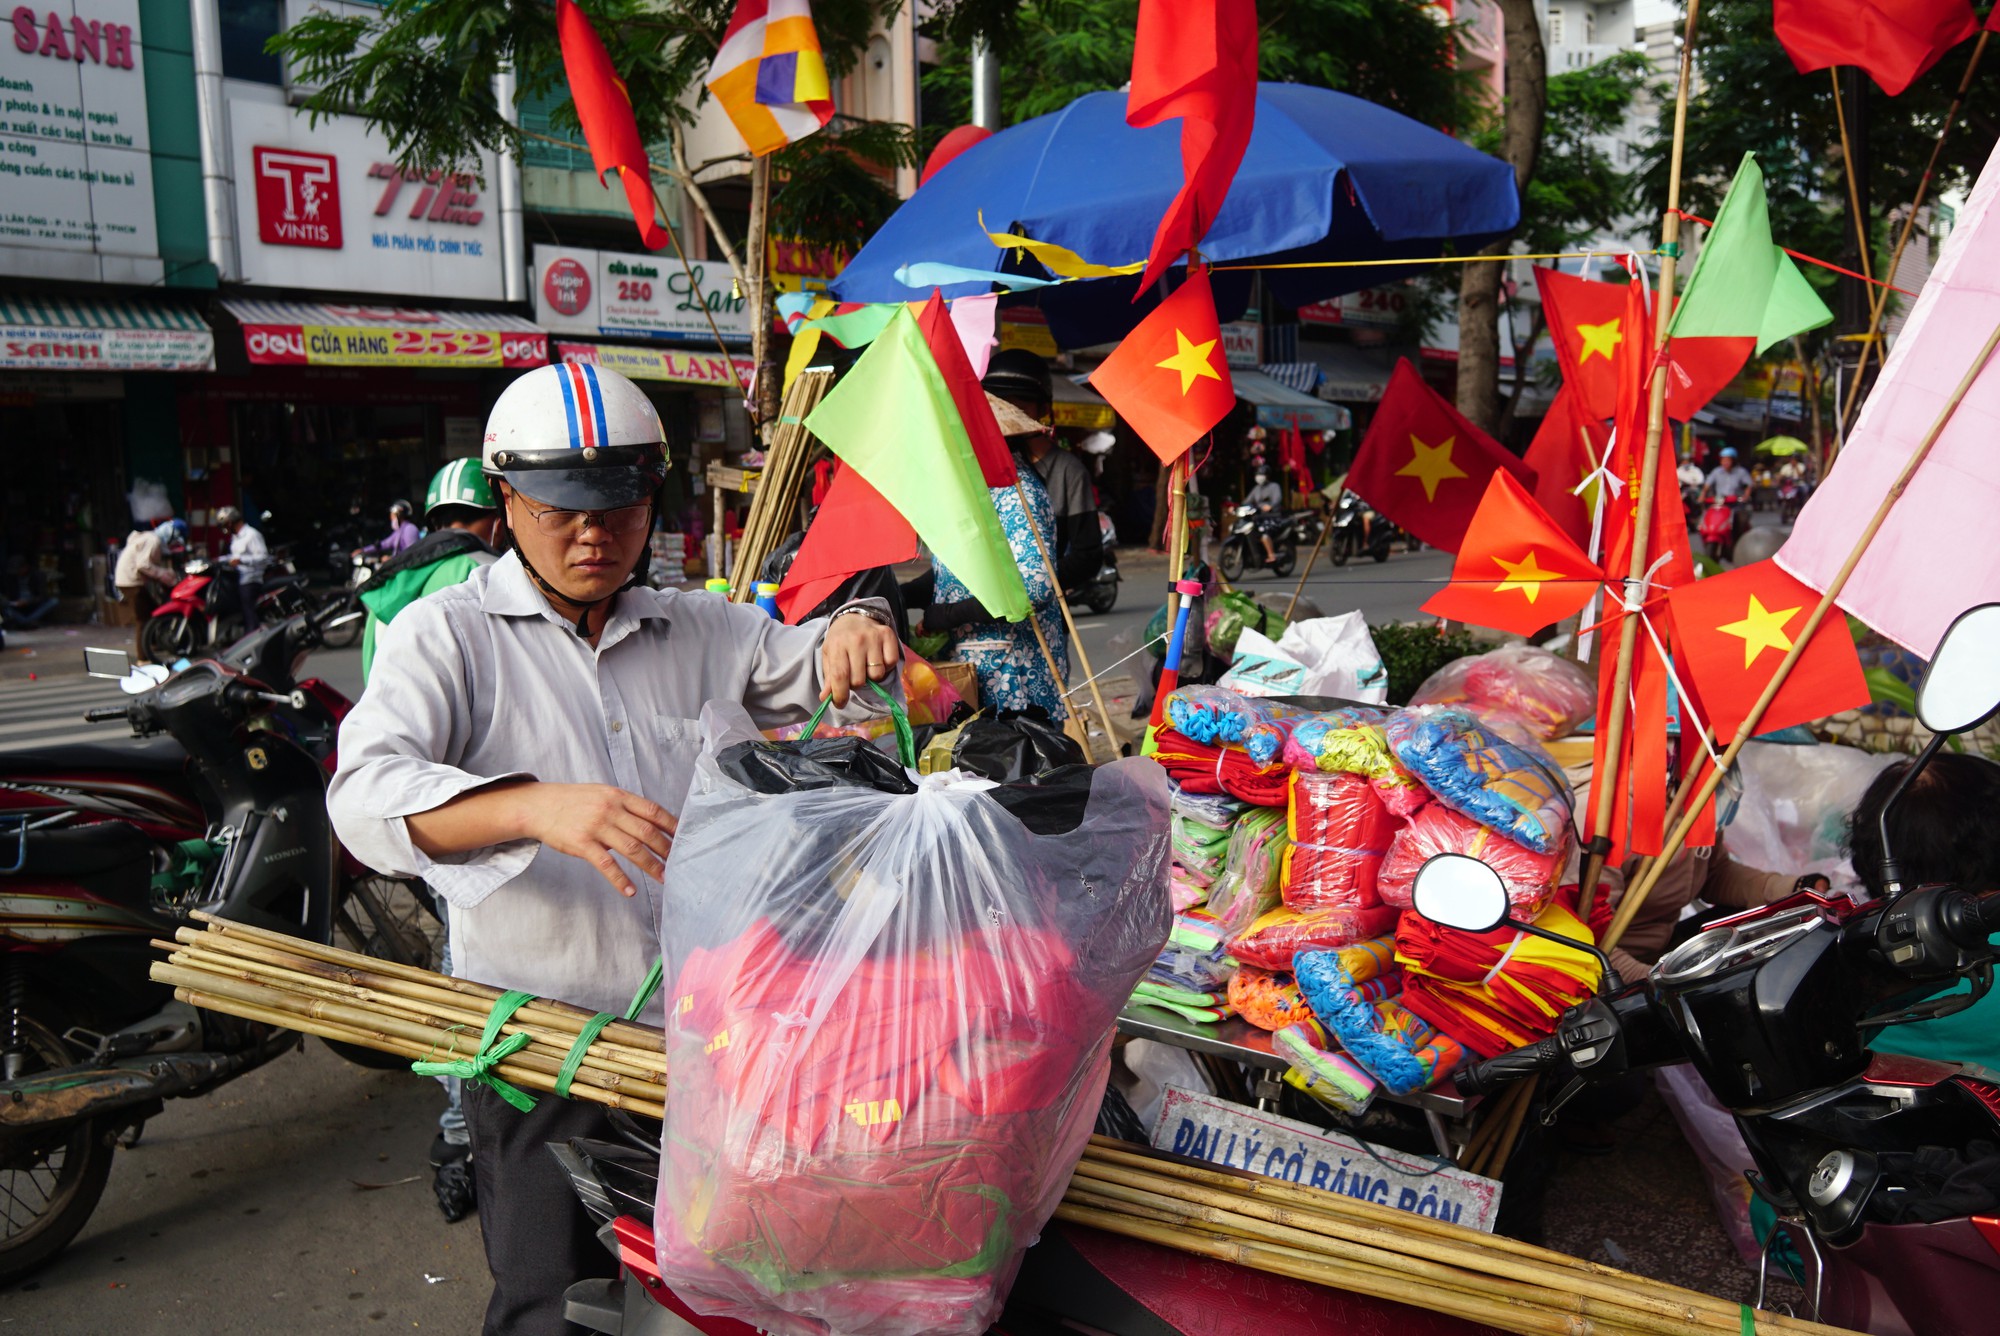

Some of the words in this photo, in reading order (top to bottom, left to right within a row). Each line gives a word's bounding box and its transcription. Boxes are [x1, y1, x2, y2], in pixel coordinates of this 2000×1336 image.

[12, 5, 134, 70] SANH
[5, 99, 39, 113] photo
[41, 125, 61, 138] các
[91, 130, 111, 144] bao
[56, 167, 75, 180] các
[101, 171, 122, 185] bao
[274, 221, 330, 242] VINTIS
[551, 273, 584, 288] Super
[667, 264, 747, 314] Lan
[557, 288, 578, 303] Ink
[618, 280, 653, 302] 250
[6, 341, 102, 361] SANH
[249, 331, 306, 357] deli
[311, 328, 343, 355] CỬA
[347, 330, 388, 355] HÀNG
[393, 331, 495, 357] 252
[502, 339, 548, 361] deli
[663, 353, 732, 383] LAN
[263, 846, 307, 864] HONDA
[1309, 1156, 1390, 1206] BĂNG
